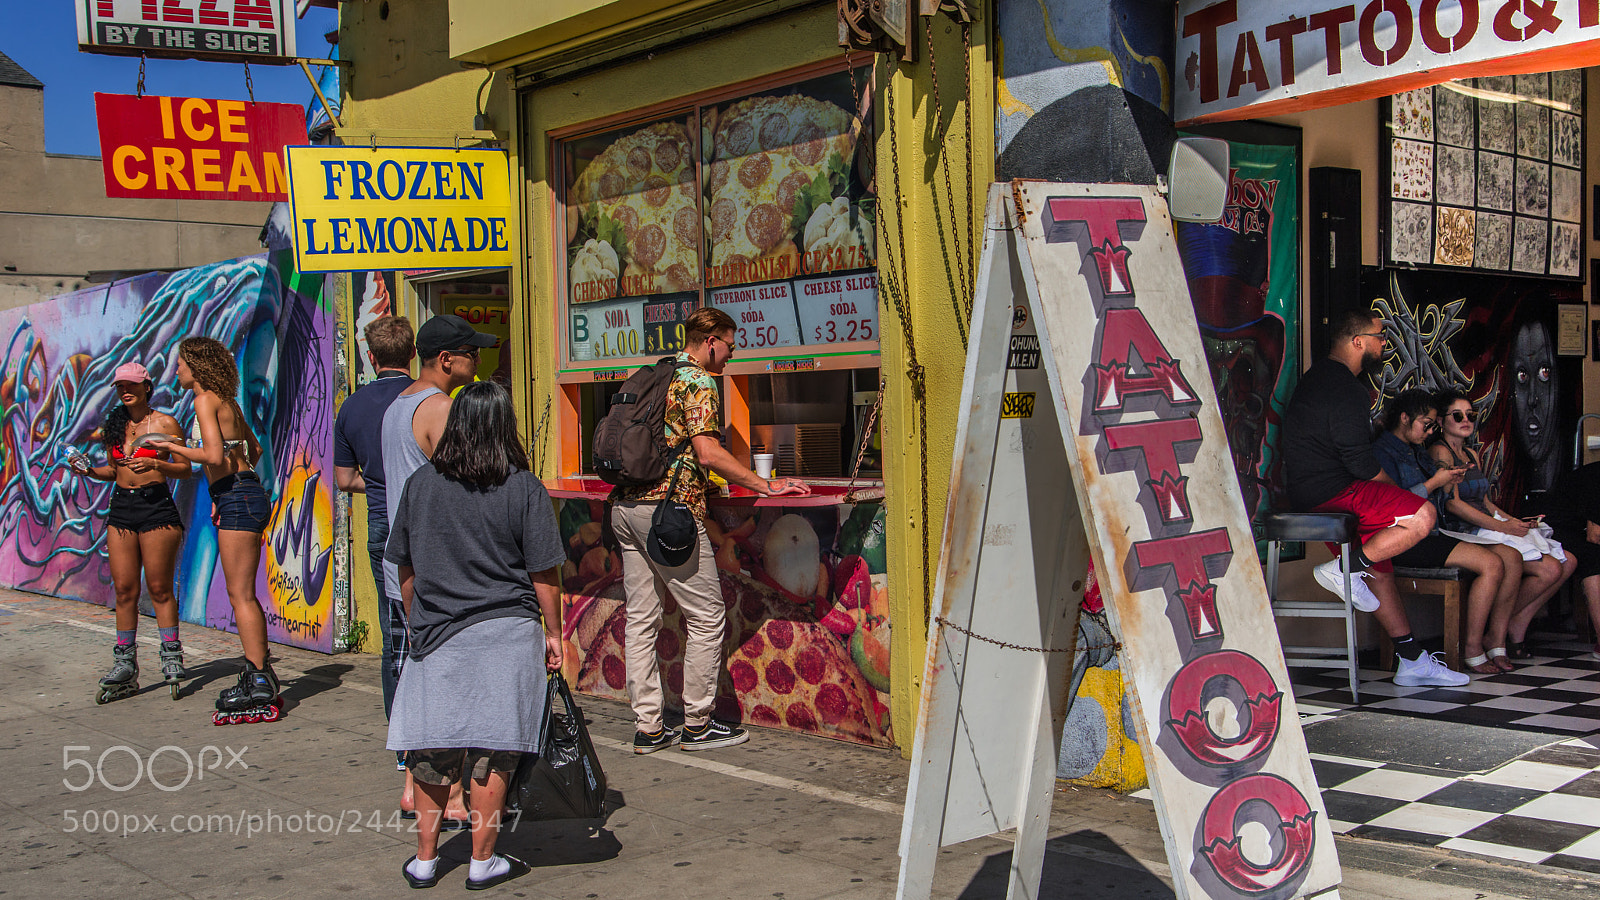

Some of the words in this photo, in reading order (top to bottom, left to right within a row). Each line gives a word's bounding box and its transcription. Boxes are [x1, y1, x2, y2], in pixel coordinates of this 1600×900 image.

[105, 25, 139, 45] BY
[147, 28, 196, 49] THE
[205, 32, 270, 53] SLICE
[1182, 0, 1480, 104] TATTOO
[159, 96, 249, 143] ICE
[112, 145, 287, 194] CREAM
[320, 160, 485, 201] FROZEN
[303, 217, 509, 255] LEMONADE
[705, 257, 775, 288] PEPERONI
[778, 250, 823, 279] SLICE
[826, 245, 866, 274] $2.75
[574, 278, 617, 302] CHEESE
[621, 273, 655, 297] SLICE
[714, 290, 756, 305] PEPERONI
[759, 285, 788, 301] SLICE
[804, 280, 843, 296] CHEESE
[845, 275, 878, 291] SLICE
[453, 305, 510, 325] SOFT
[605, 308, 631, 329] SODA
[644, 302, 677, 323] CHEESE
[741, 310, 765, 324] SODA
[830, 302, 858, 317] SODA
[573, 314, 589, 342] B
[648, 323, 686, 353] $1.9
[737, 325, 778, 349] 3.50
[814, 318, 873, 343] $3.25
[595, 328, 639, 357] $1.00
[1045, 196, 1318, 898] TATTOO
